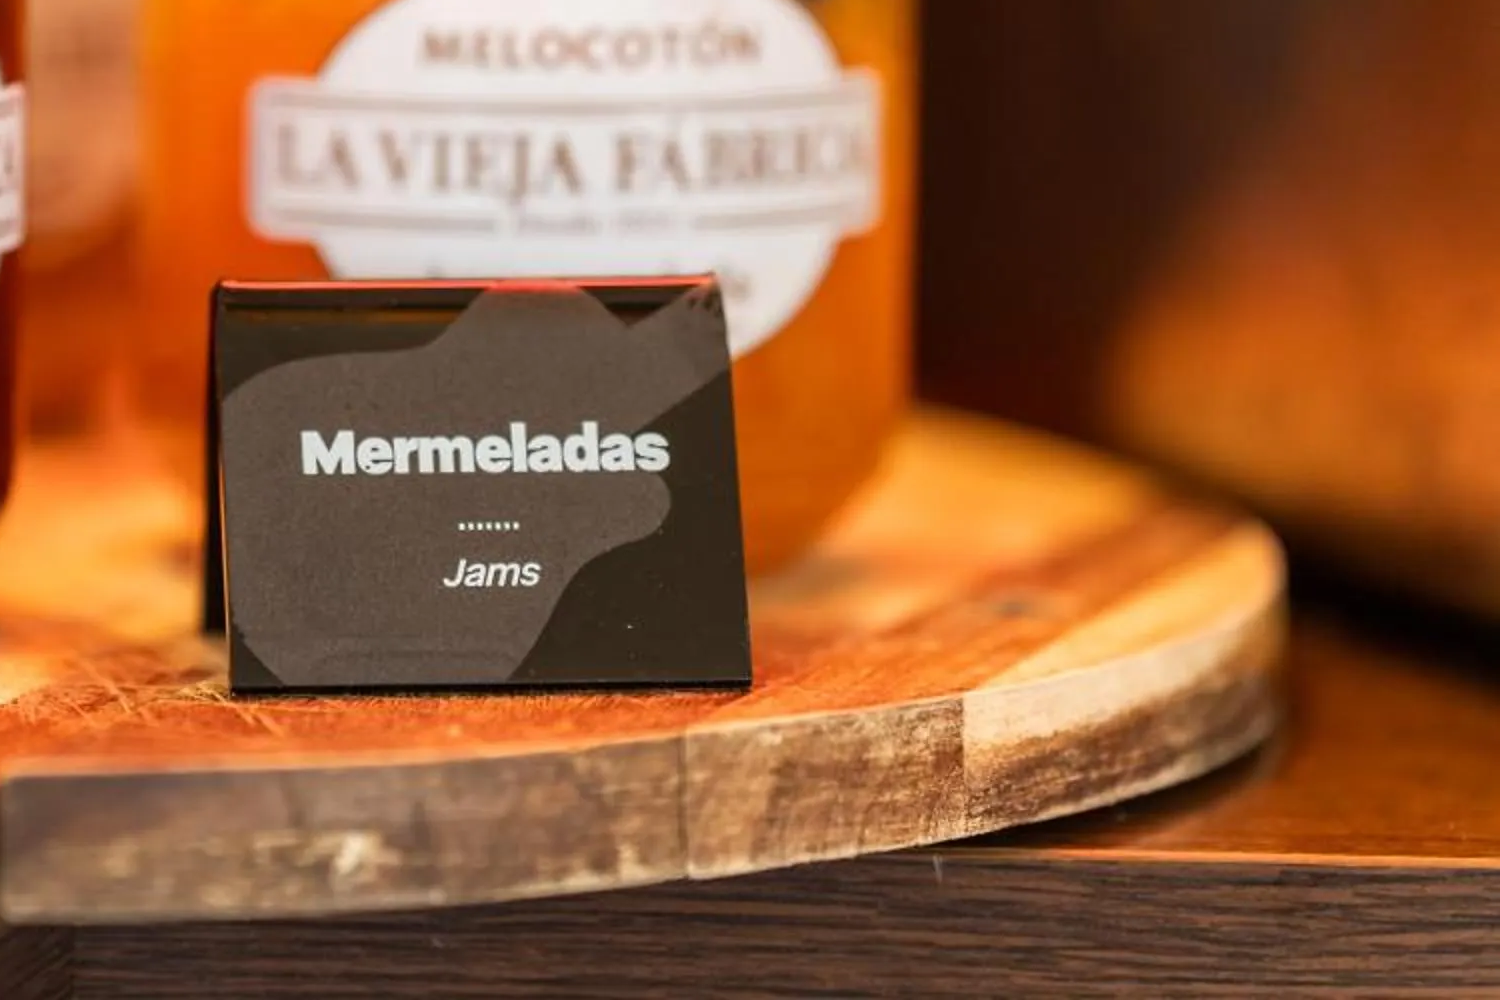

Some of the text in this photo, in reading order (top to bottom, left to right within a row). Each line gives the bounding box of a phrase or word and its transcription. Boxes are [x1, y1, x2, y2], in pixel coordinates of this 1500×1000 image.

[417, 18, 762, 70] MELOCOTÓN
[275, 122, 361, 188] LA
[375, 124, 586, 206] VIEJA
[301, 421, 671, 475] Mermeladas
[443, 558, 542, 588] Jams
